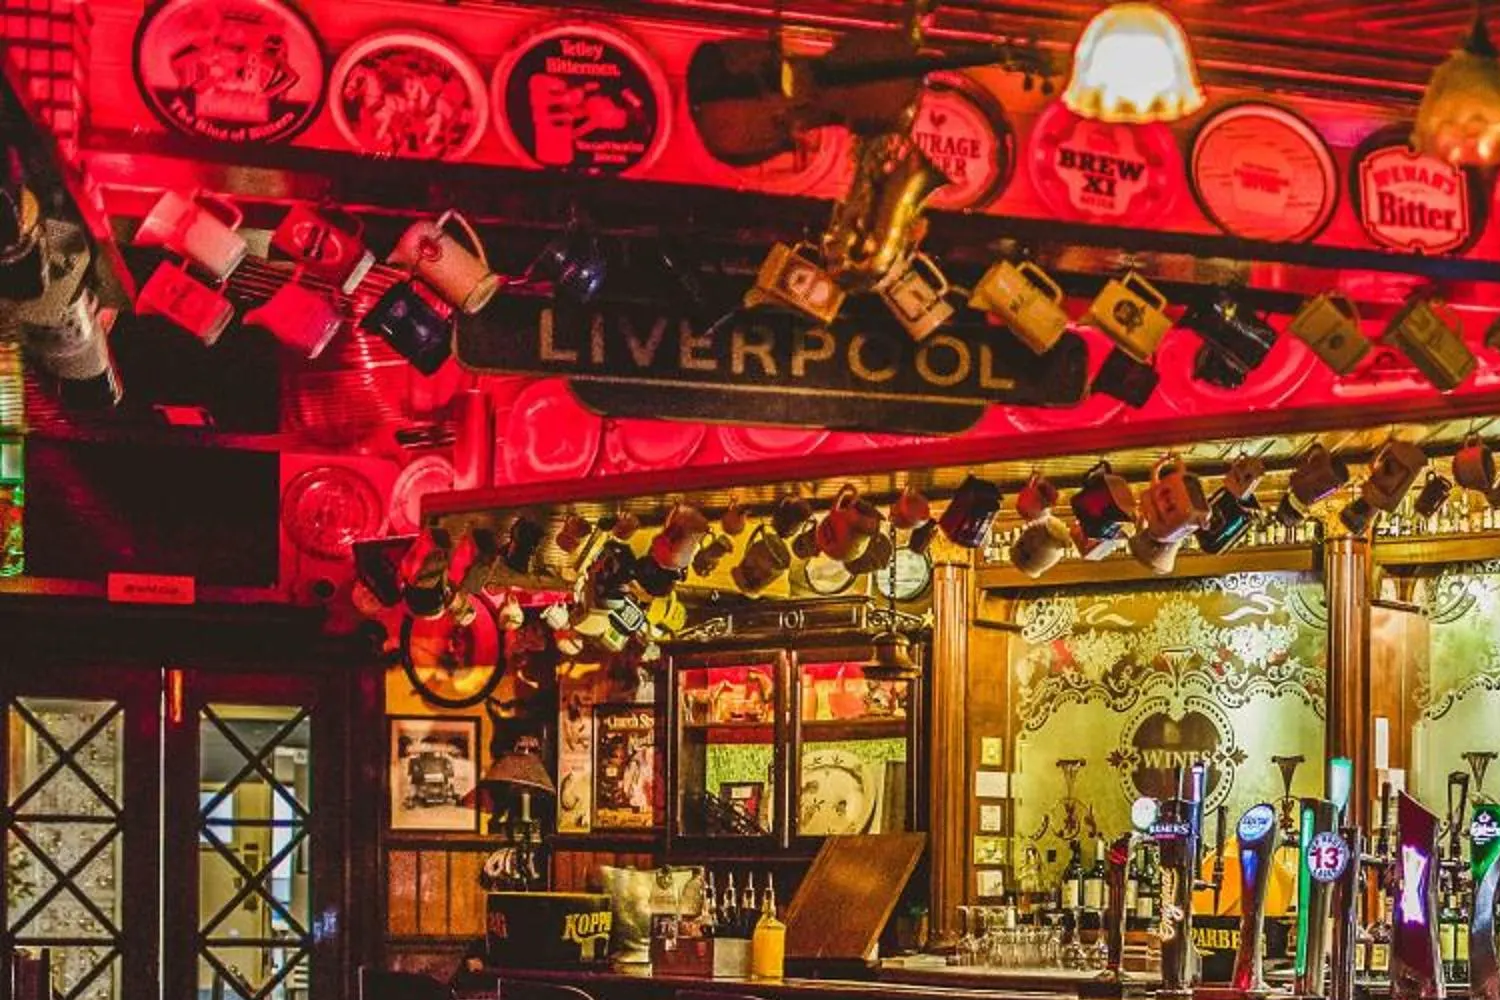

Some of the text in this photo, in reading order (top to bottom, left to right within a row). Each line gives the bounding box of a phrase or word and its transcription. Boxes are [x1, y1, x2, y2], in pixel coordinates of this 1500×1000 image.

[915, 132, 982, 159] URAGE
[1058, 148, 1145, 181] BREW
[1082, 174, 1117, 198] XI
[1377, 190, 1458, 231] Bitter
[539, 308, 1015, 390] LIVERPOOL
[1142, 749, 1211, 769] WINES
[1313, 846, 1340, 869] 13
